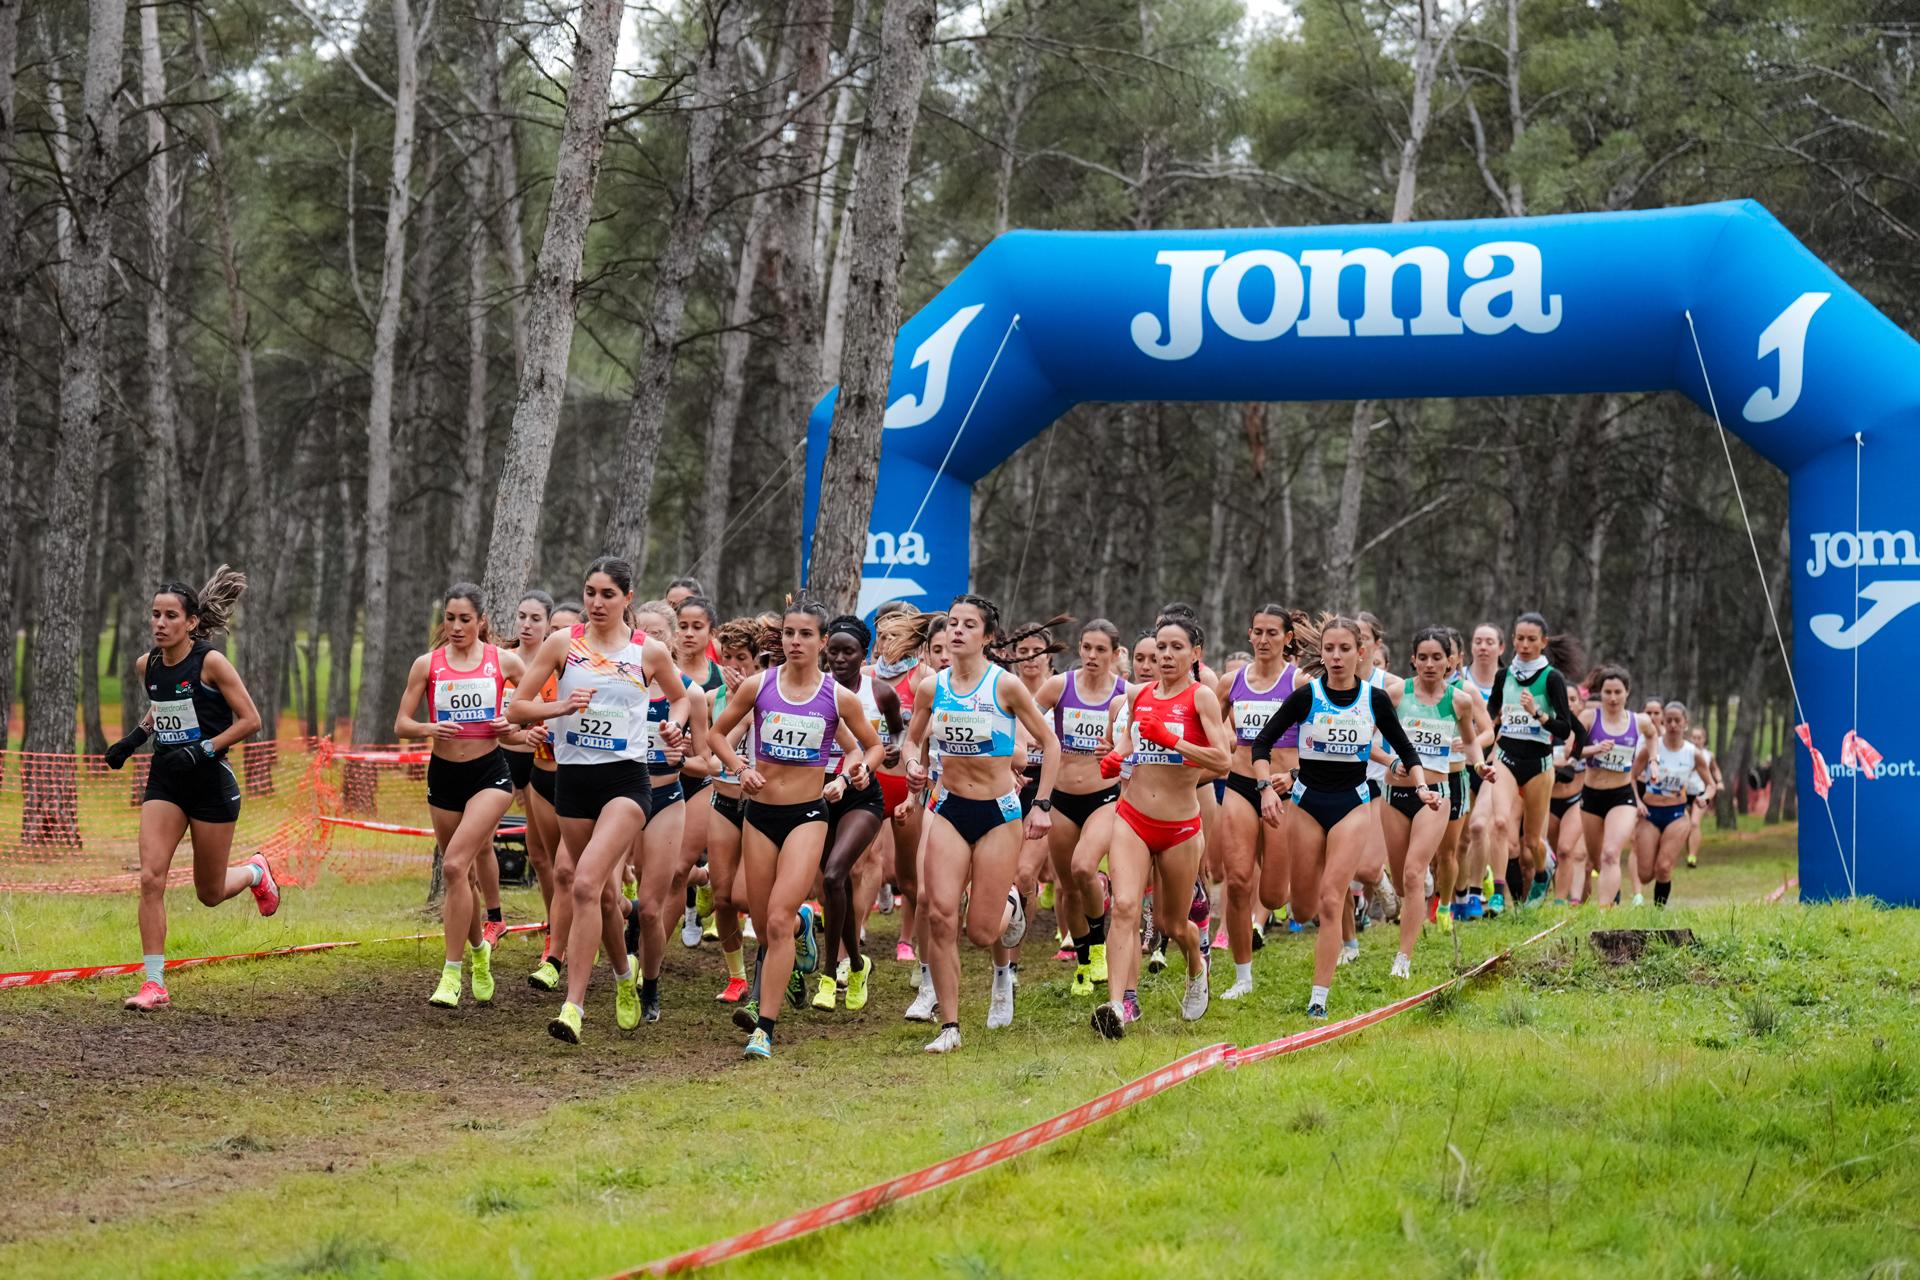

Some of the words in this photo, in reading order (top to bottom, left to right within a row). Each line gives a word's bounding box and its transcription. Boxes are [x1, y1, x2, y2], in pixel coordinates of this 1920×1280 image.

[1130, 241, 1563, 361] Joma
[862, 531, 931, 566] ma
[1806, 529, 1920, 578] Jom
[450, 693, 483, 709] 600
[156, 715, 182, 730] 620
[448, 709, 487, 722] Joma
[1243, 714, 1271, 727] 407
[580, 718, 613, 737] 522
[945, 726, 975, 742] 552
[1075, 723, 1104, 737] 408
[574, 734, 616, 750] Joma
[772, 728, 808, 747] 417
[1071, 736, 1098, 748] Jom
[1327, 728, 1358, 743] 550
[1414, 730, 1442, 745] 358
[768, 744, 809, 760] Joma
[945, 742, 982, 754] Joma
[1323, 743, 1359, 754] Joma
[1137, 753, 1171, 764] Joma
[1604, 753, 1625, 765] 412
